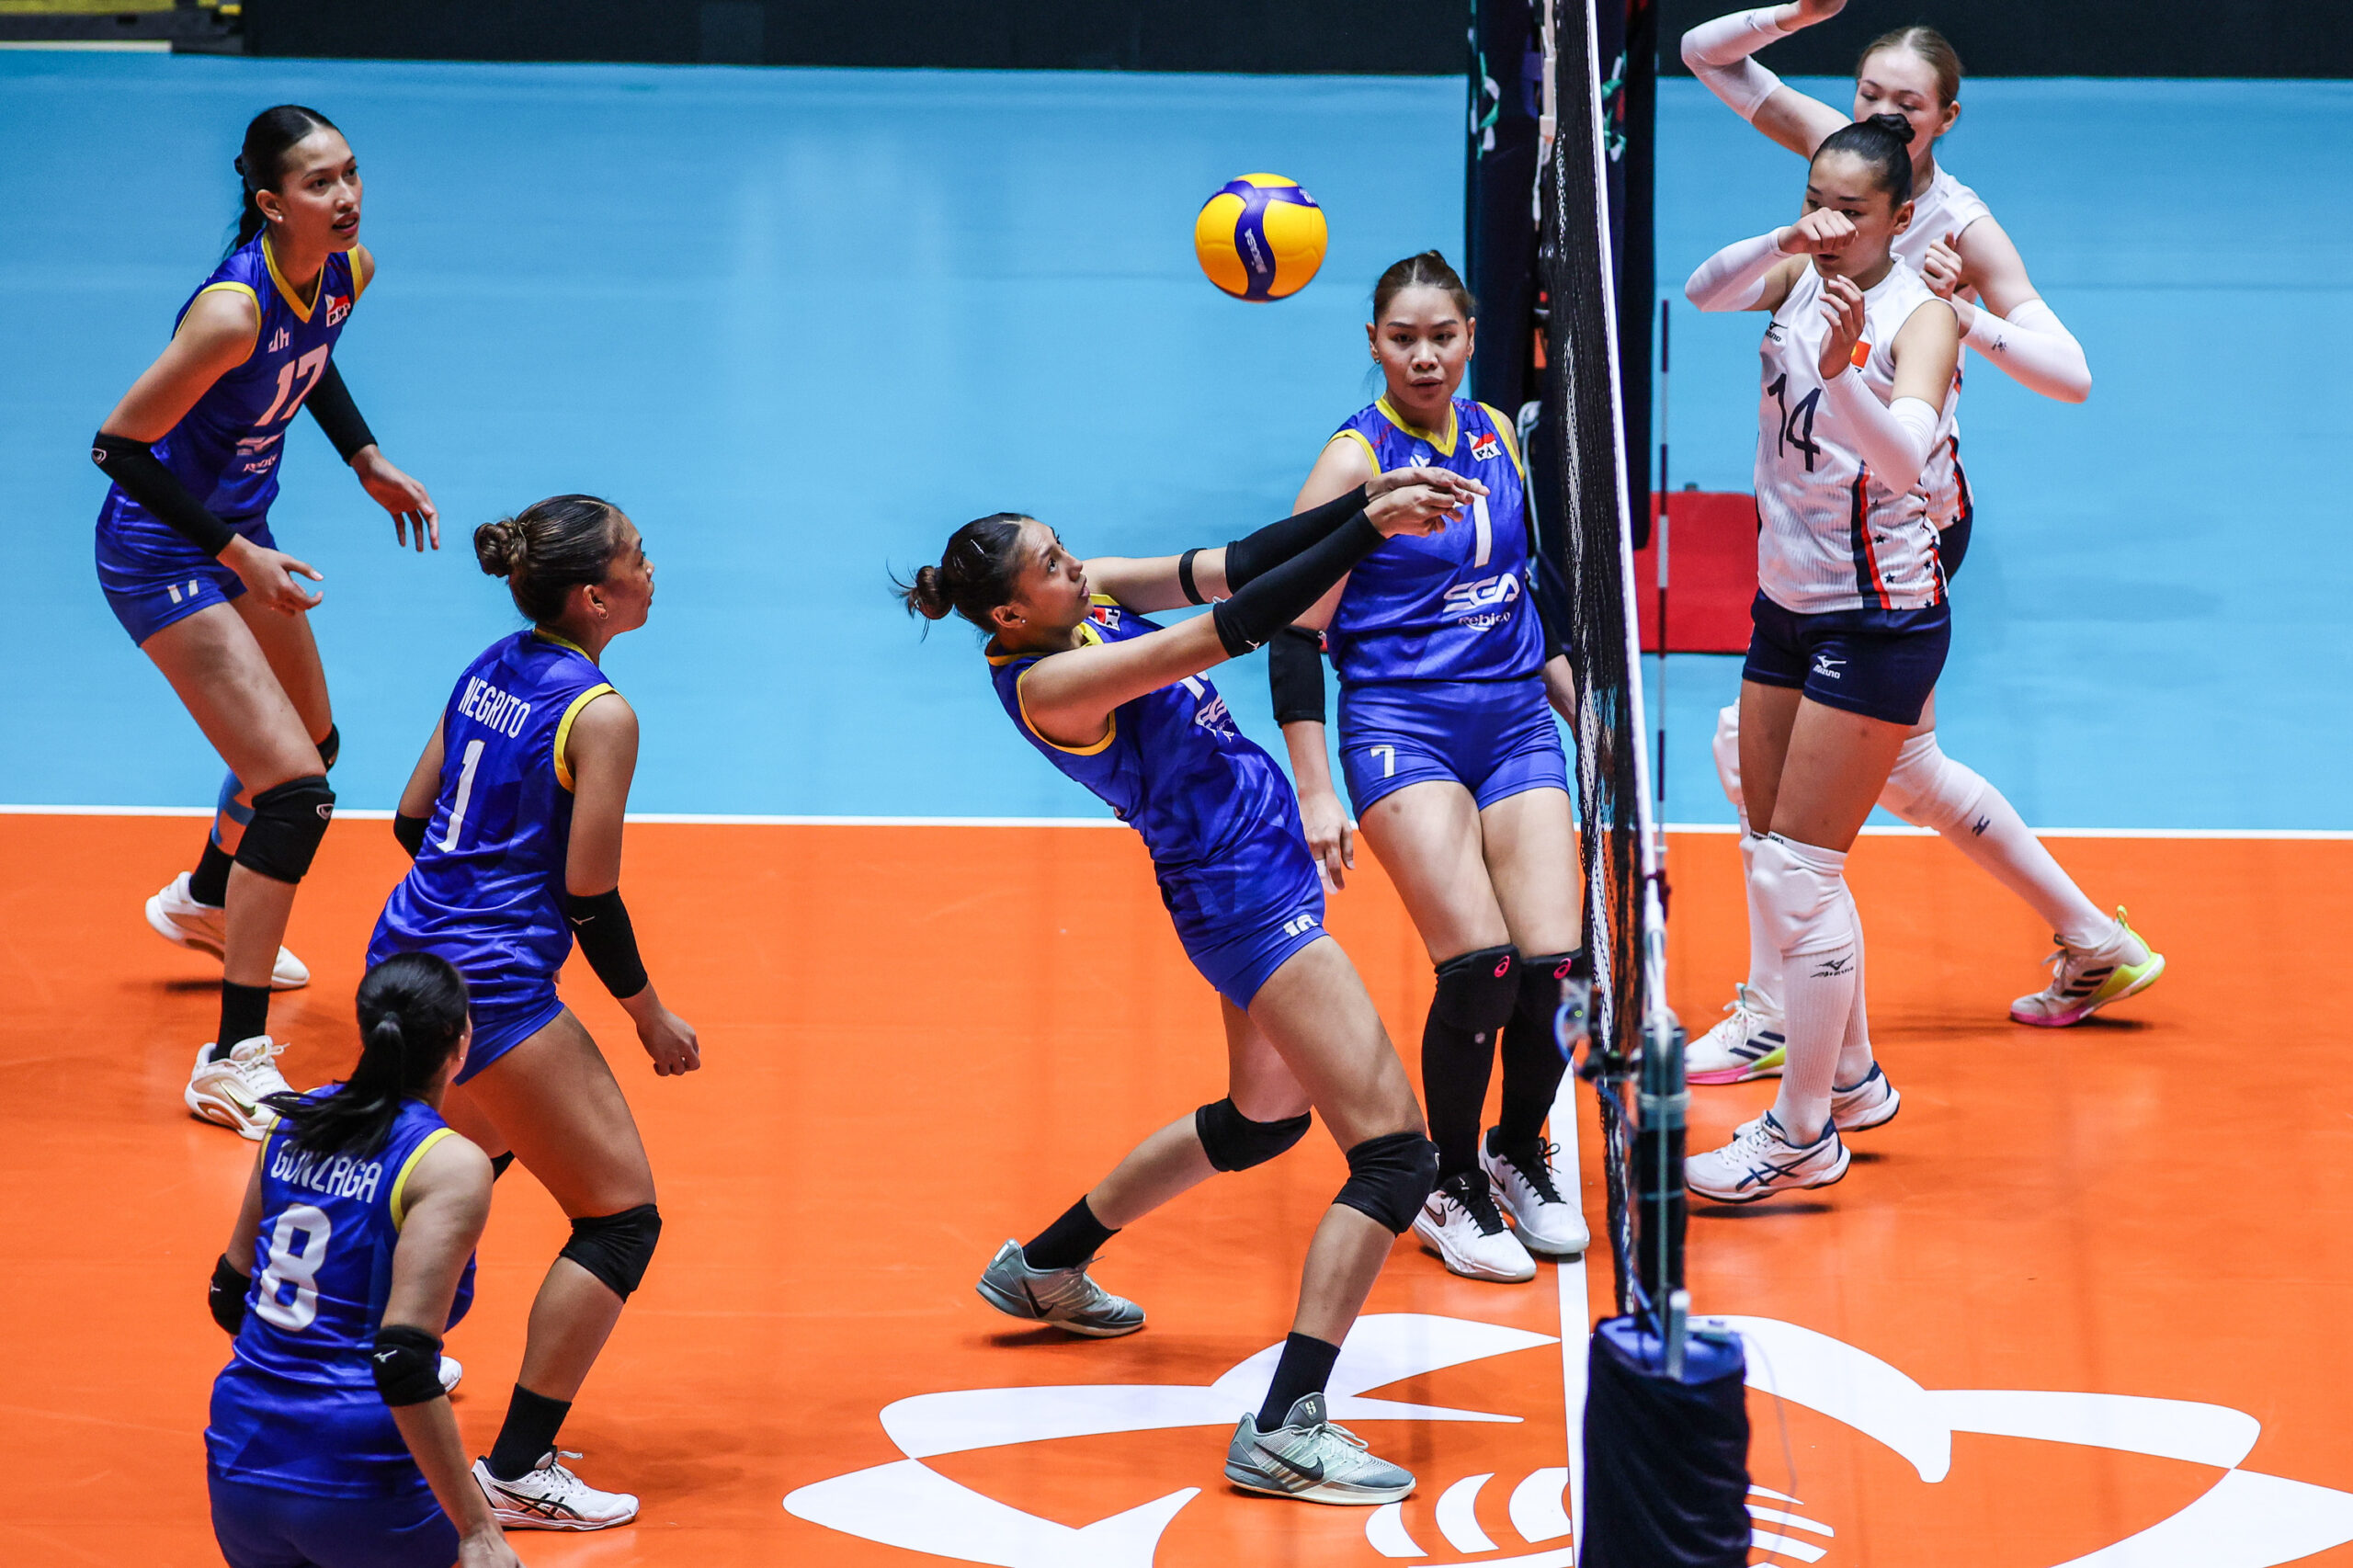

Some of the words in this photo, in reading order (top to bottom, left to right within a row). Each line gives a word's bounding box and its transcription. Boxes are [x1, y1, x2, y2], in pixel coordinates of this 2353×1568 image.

[254, 343, 329, 426] 17
[1767, 372, 1822, 472] 14
[458, 676, 531, 739] NEGRITO
[437, 738, 485, 853] 1
[1370, 744, 1395, 778] 7
[270, 1140, 382, 1204] GONZAGA
[256, 1203, 332, 1332] 8
